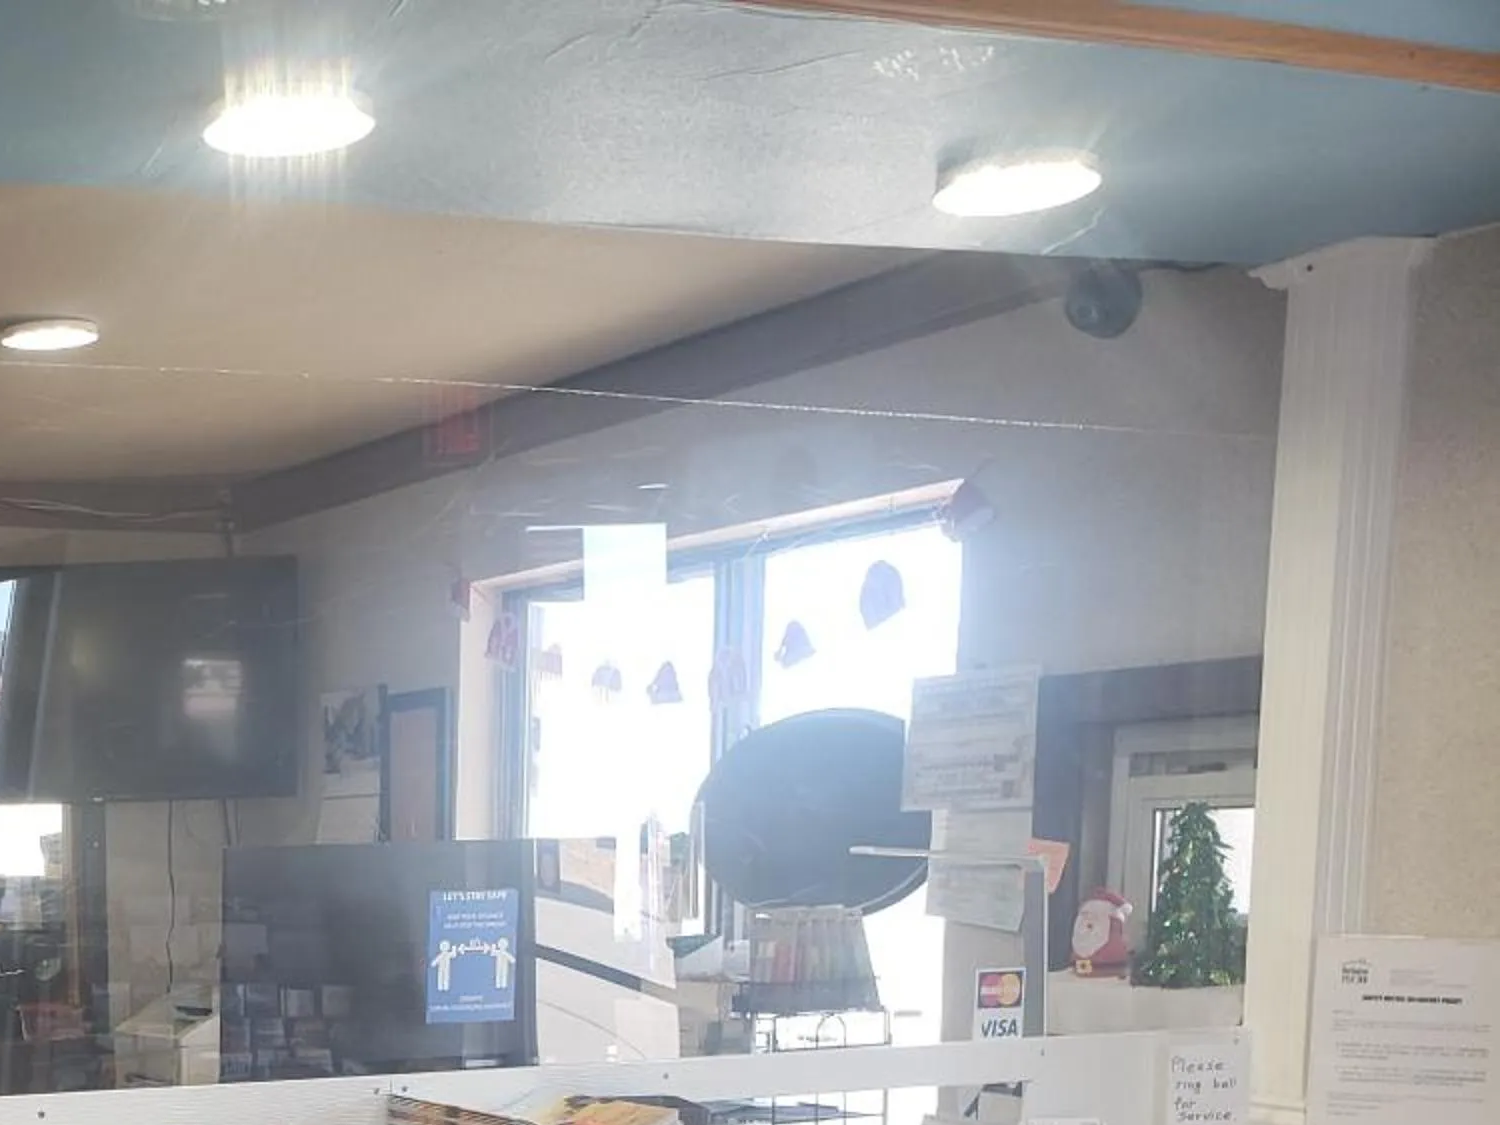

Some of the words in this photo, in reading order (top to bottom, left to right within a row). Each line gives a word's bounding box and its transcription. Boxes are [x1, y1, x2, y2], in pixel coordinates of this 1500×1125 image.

[982, 1018, 1018, 1037] VISA
[1171, 1056, 1223, 1073] Please
[1176, 1080, 1202, 1095] ring
[1174, 1096, 1197, 1111] for
